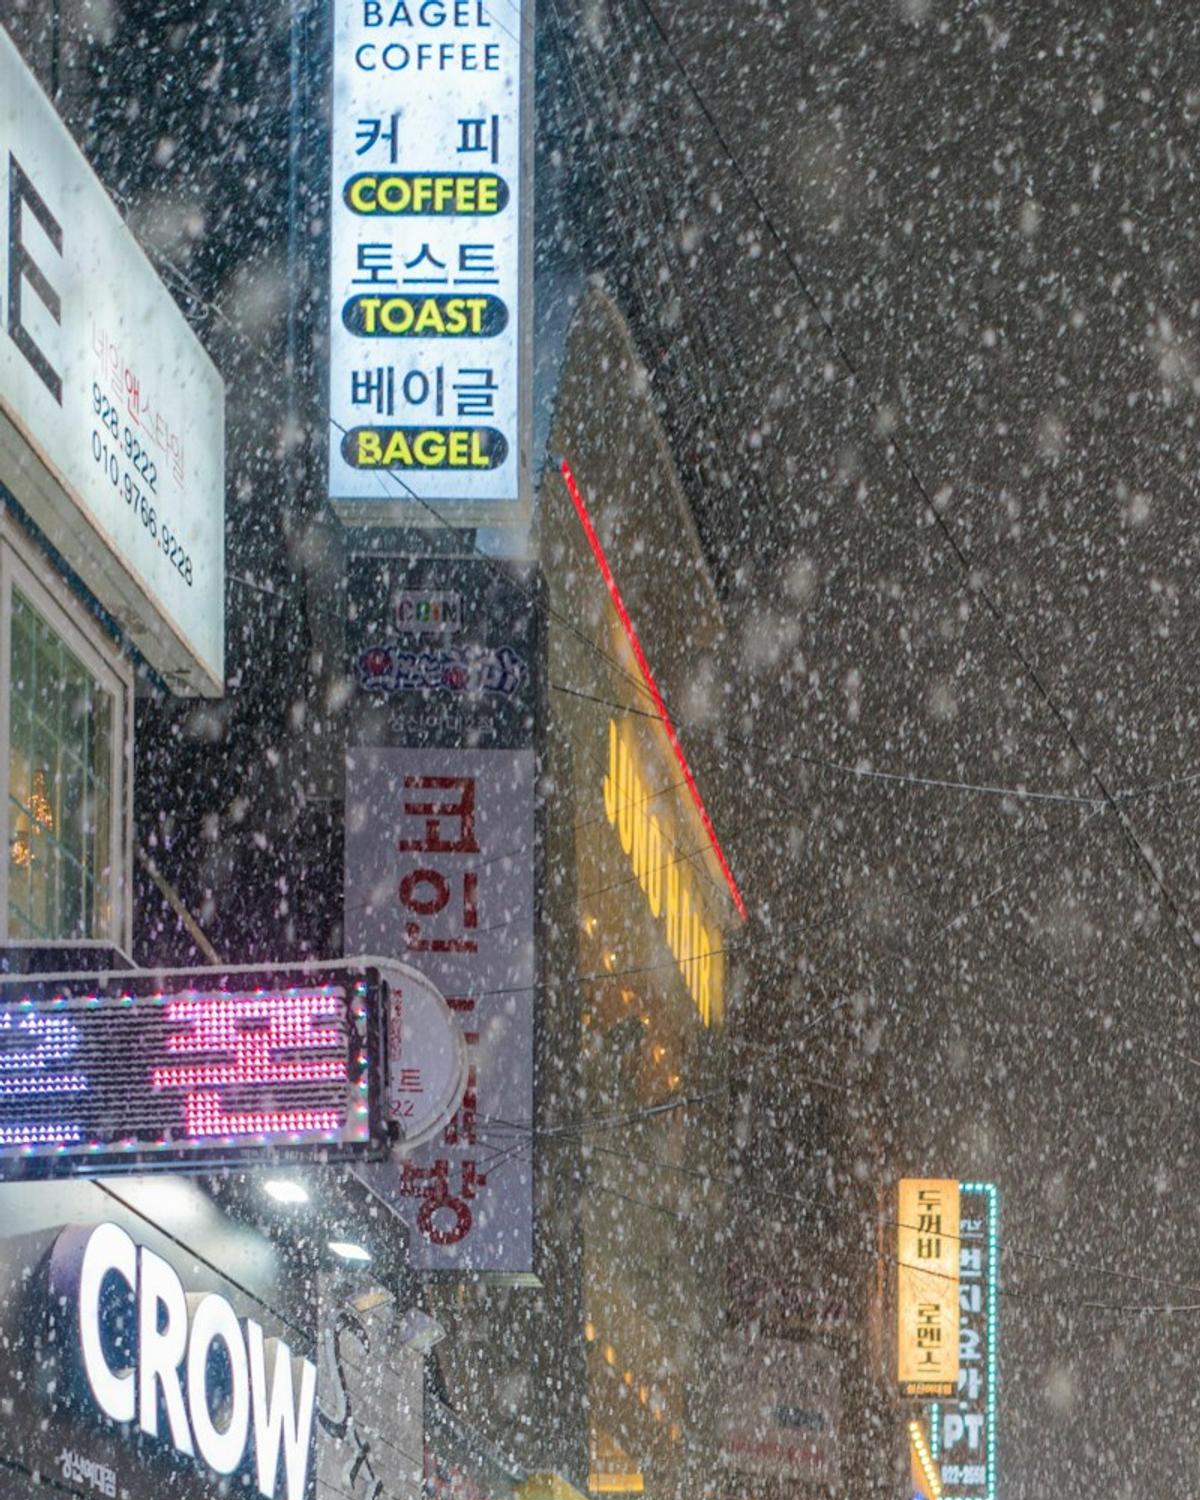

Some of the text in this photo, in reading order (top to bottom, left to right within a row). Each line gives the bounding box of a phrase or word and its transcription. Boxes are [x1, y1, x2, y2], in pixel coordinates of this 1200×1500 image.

[363, 0, 491, 28] BAGEL
[355, 43, 500, 72] COFFEE
[354, 113, 500, 165] 커피
[350, 177, 499, 213] COFFEE
[351, 244, 500, 286] 토스트
[360, 299, 486, 332] TOAST
[351, 366, 499, 419] 베이글
[92, 381, 158, 495] 928.9222
[357, 431, 489, 466] BAGEL
[399, 776, 486, 1245] 코인방
[917, 1189, 942, 1259] 두꺼비
[943, 1413, 984, 1449] PT
